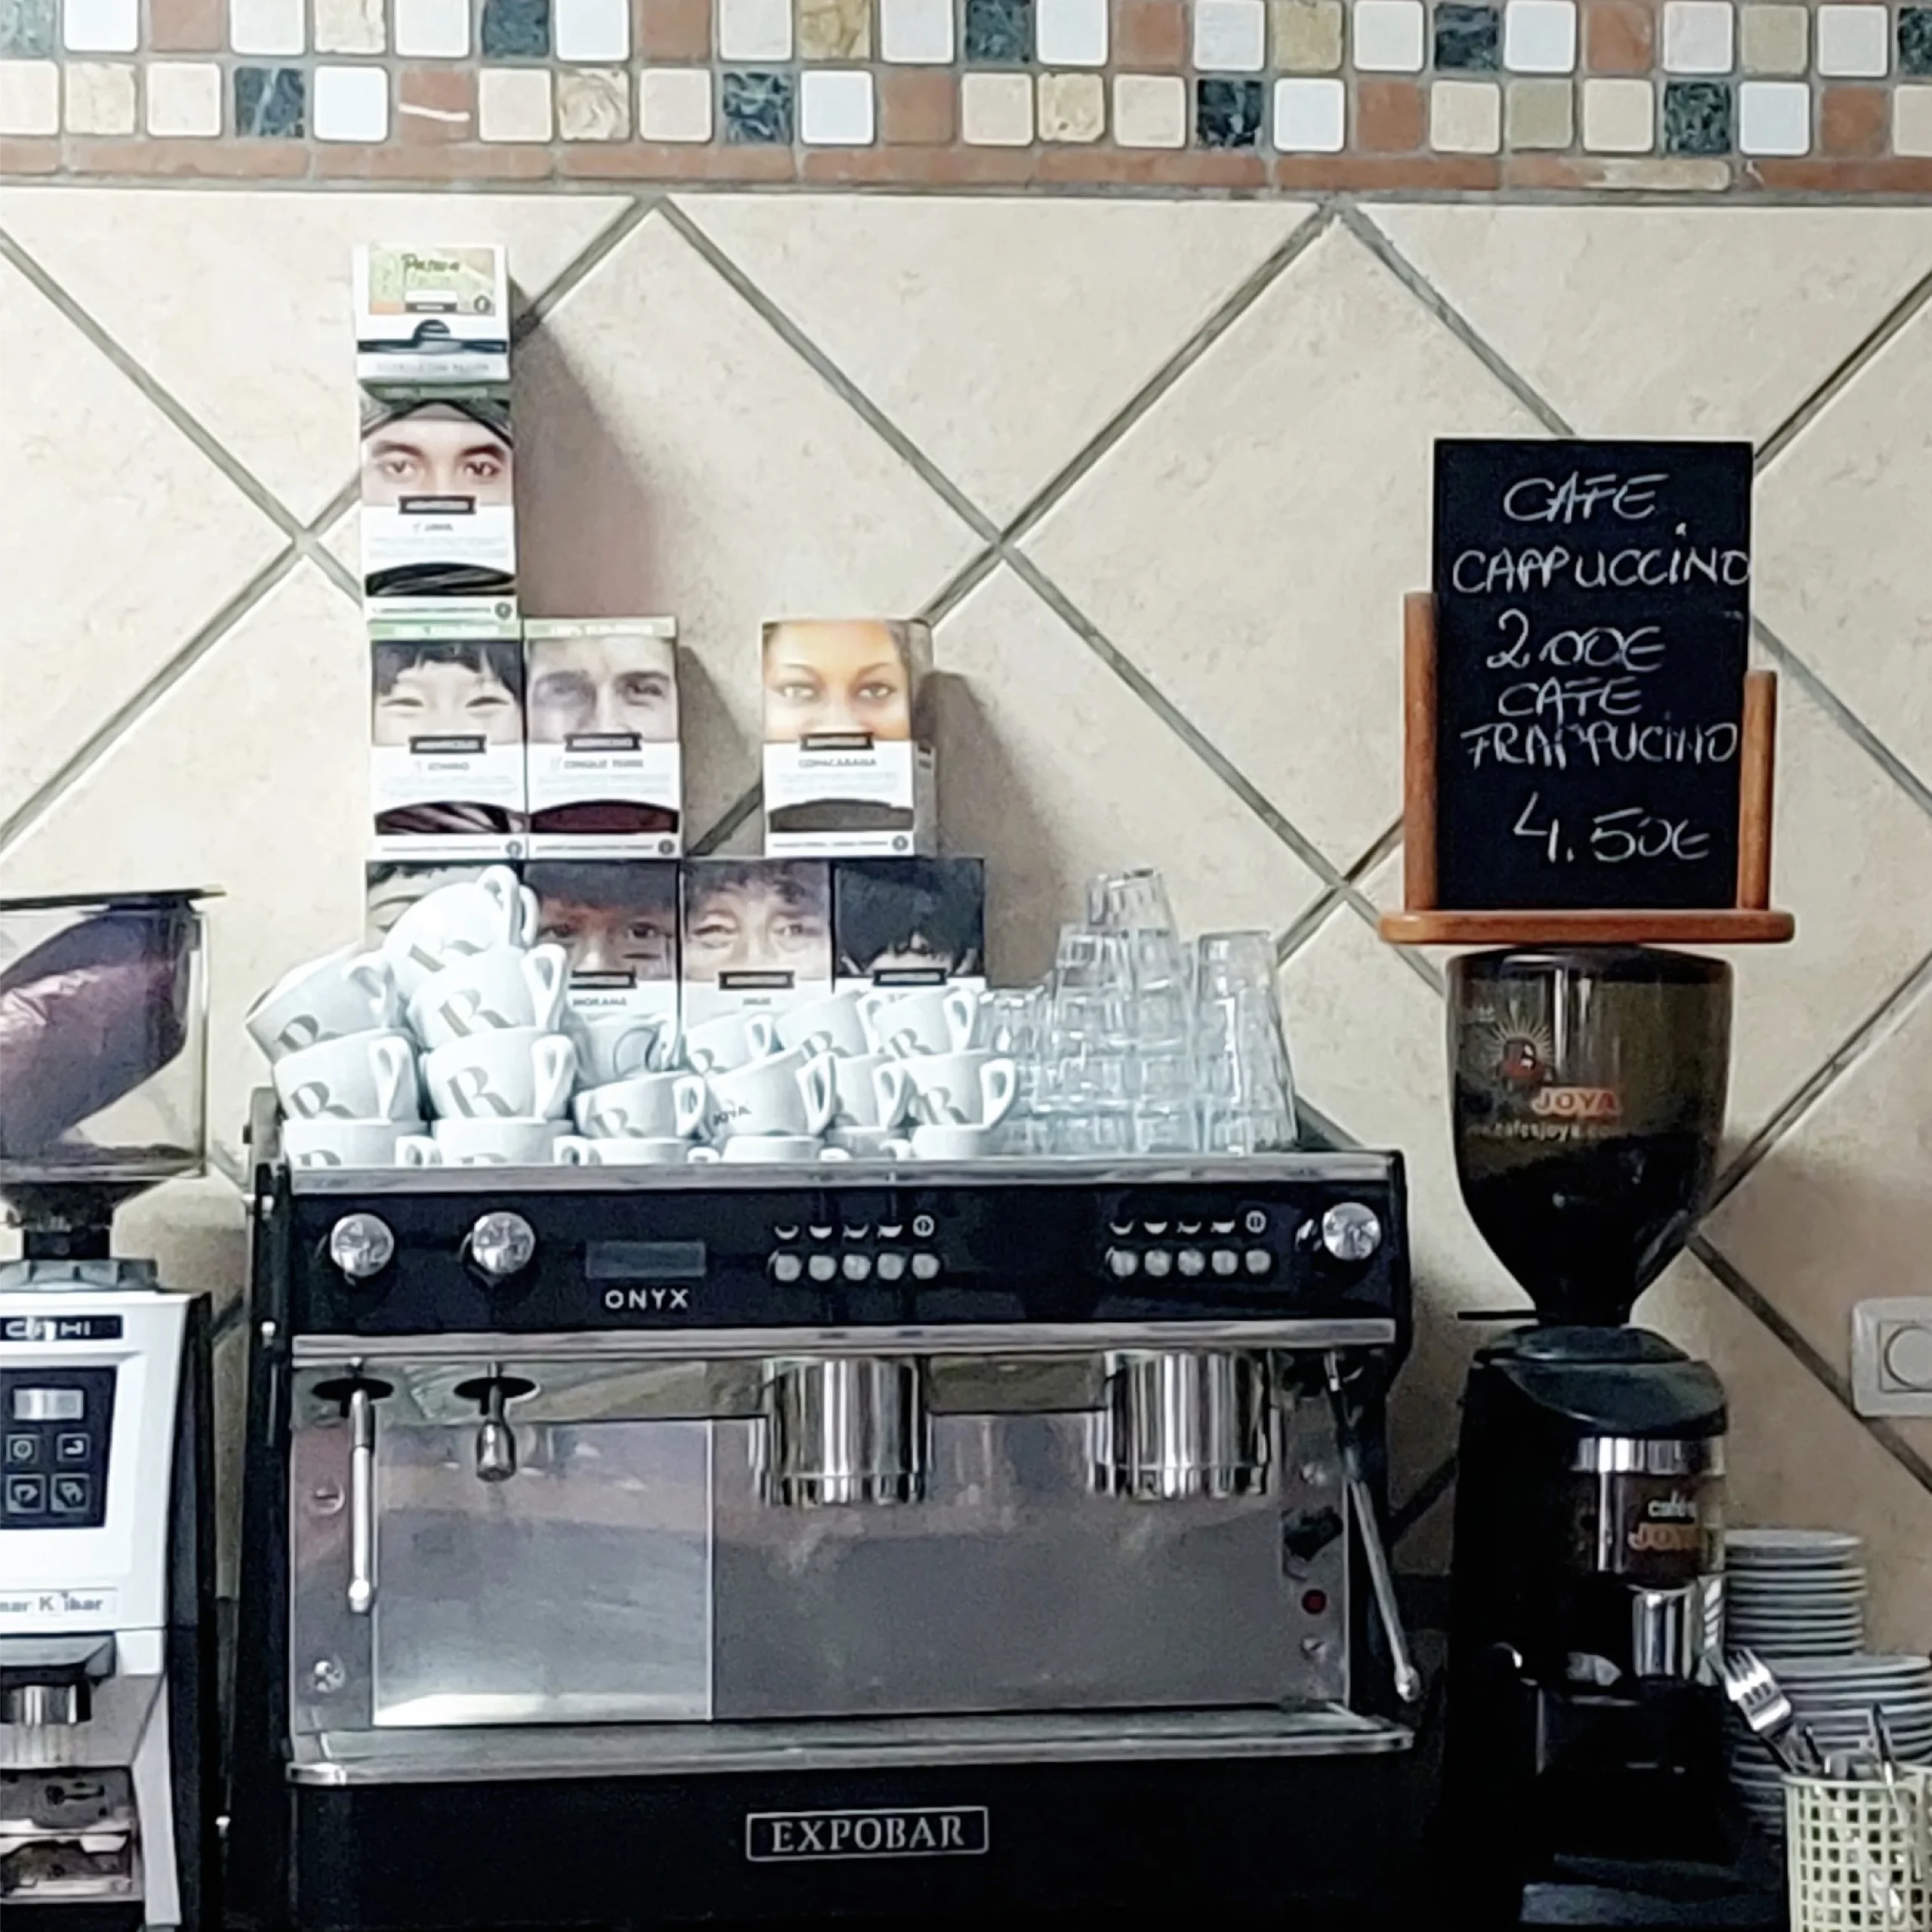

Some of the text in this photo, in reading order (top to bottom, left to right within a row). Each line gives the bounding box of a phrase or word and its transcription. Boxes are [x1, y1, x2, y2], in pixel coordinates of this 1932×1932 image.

[1503, 471, 1669, 523] CAFE
[1452, 521, 1751, 593] CAPPUCCINO
[1498, 677, 1643, 723] CAFE
[1512, 791, 1710, 863] 4.50€
[1532, 1089, 1621, 1115] JOYA
[605, 1288, 689, 1309] ONYX
[771, 1815, 964, 1853] EXPOBAR
